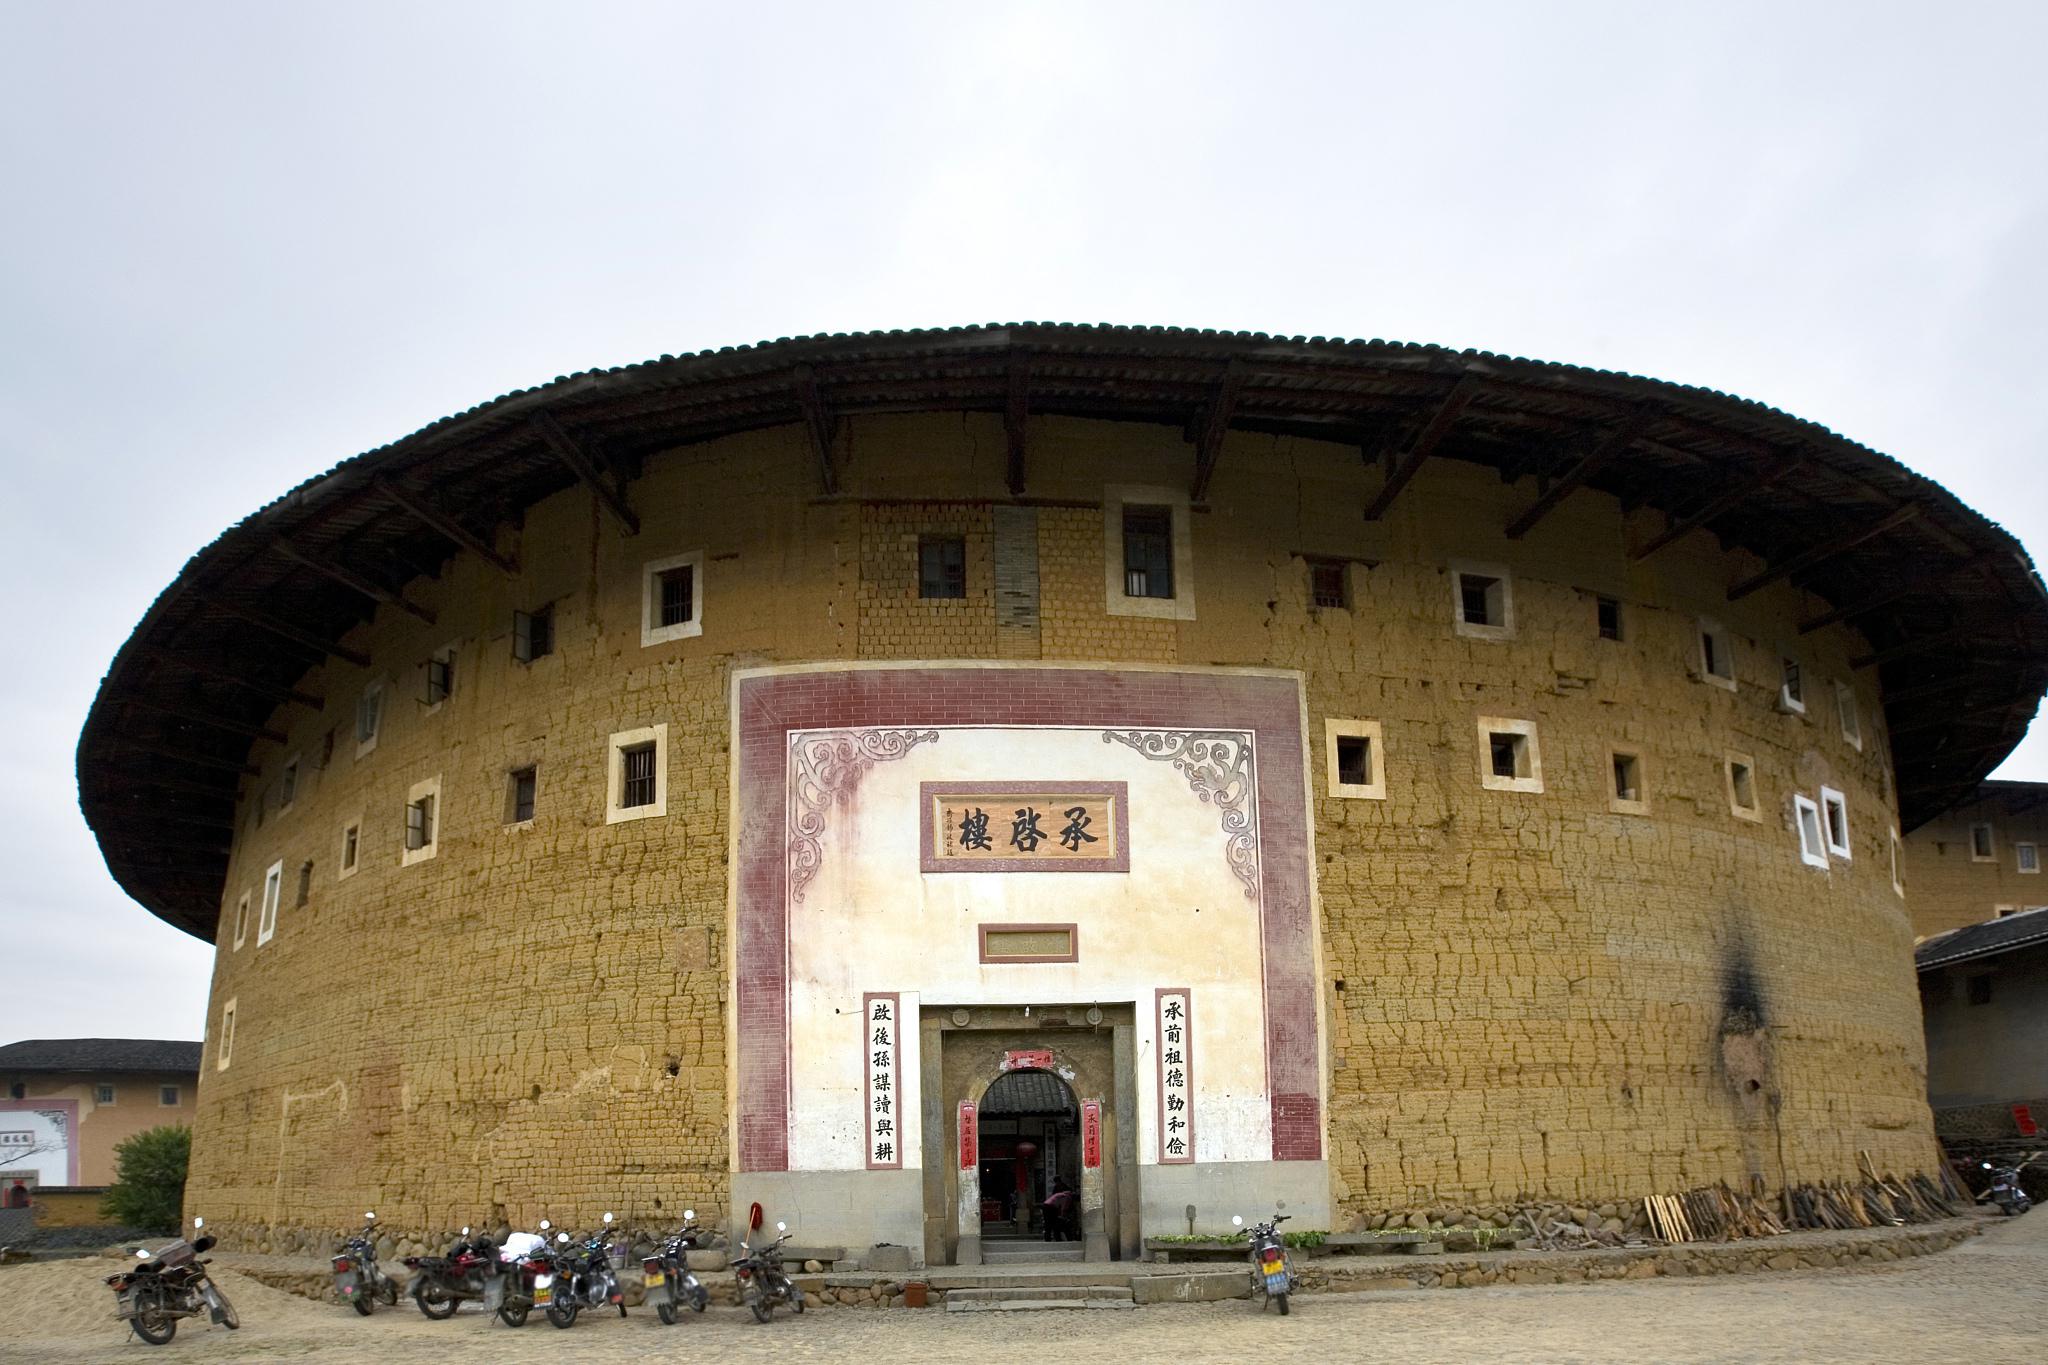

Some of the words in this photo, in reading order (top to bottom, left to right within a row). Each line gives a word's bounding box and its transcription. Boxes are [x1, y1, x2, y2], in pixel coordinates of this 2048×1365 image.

[1165, 1002, 1185, 1154] 承前祖德勤和儉
